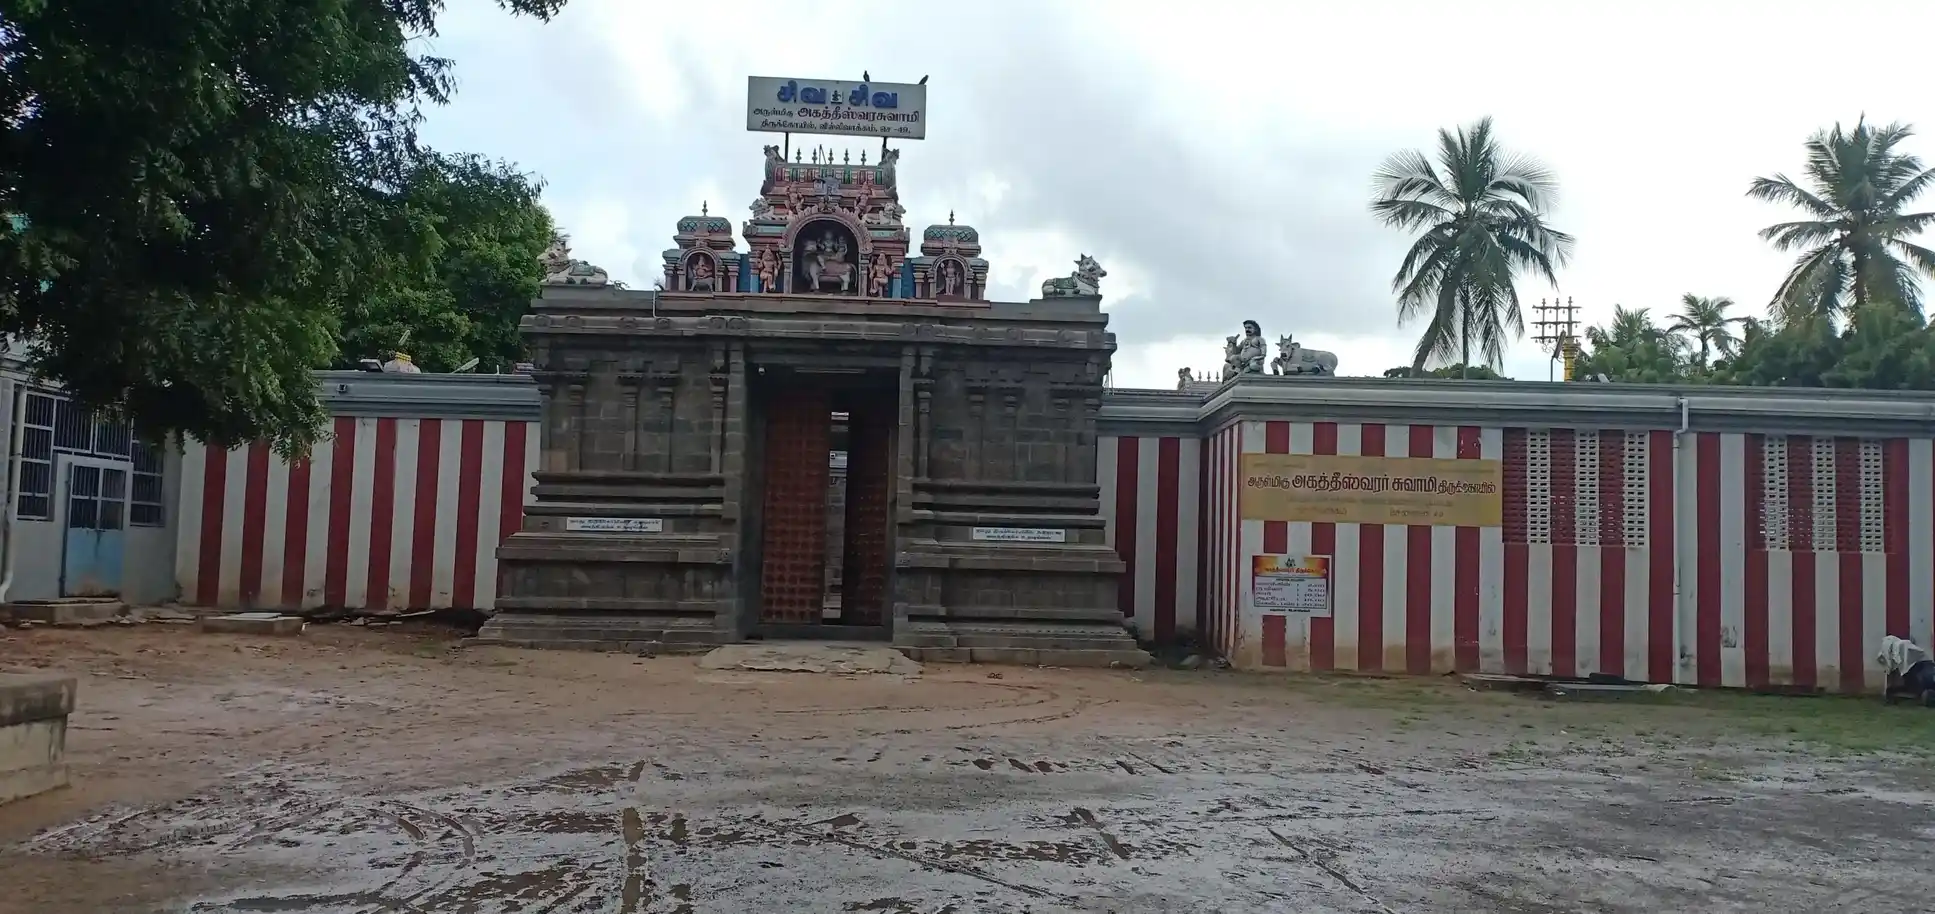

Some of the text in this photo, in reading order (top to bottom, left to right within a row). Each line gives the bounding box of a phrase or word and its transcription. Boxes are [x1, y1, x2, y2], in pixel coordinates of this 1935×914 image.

[777, 79, 898, 109] சிவ சிவ
[797, 106, 920, 123] அகத்தீஸ்வரசுவாமி
[1247, 475, 1291, 490] அருள்மிகு
[1291, 472, 1390, 493] அகத்தீஸ்வரர்
[1392, 475, 1438, 493] சுவாமி
